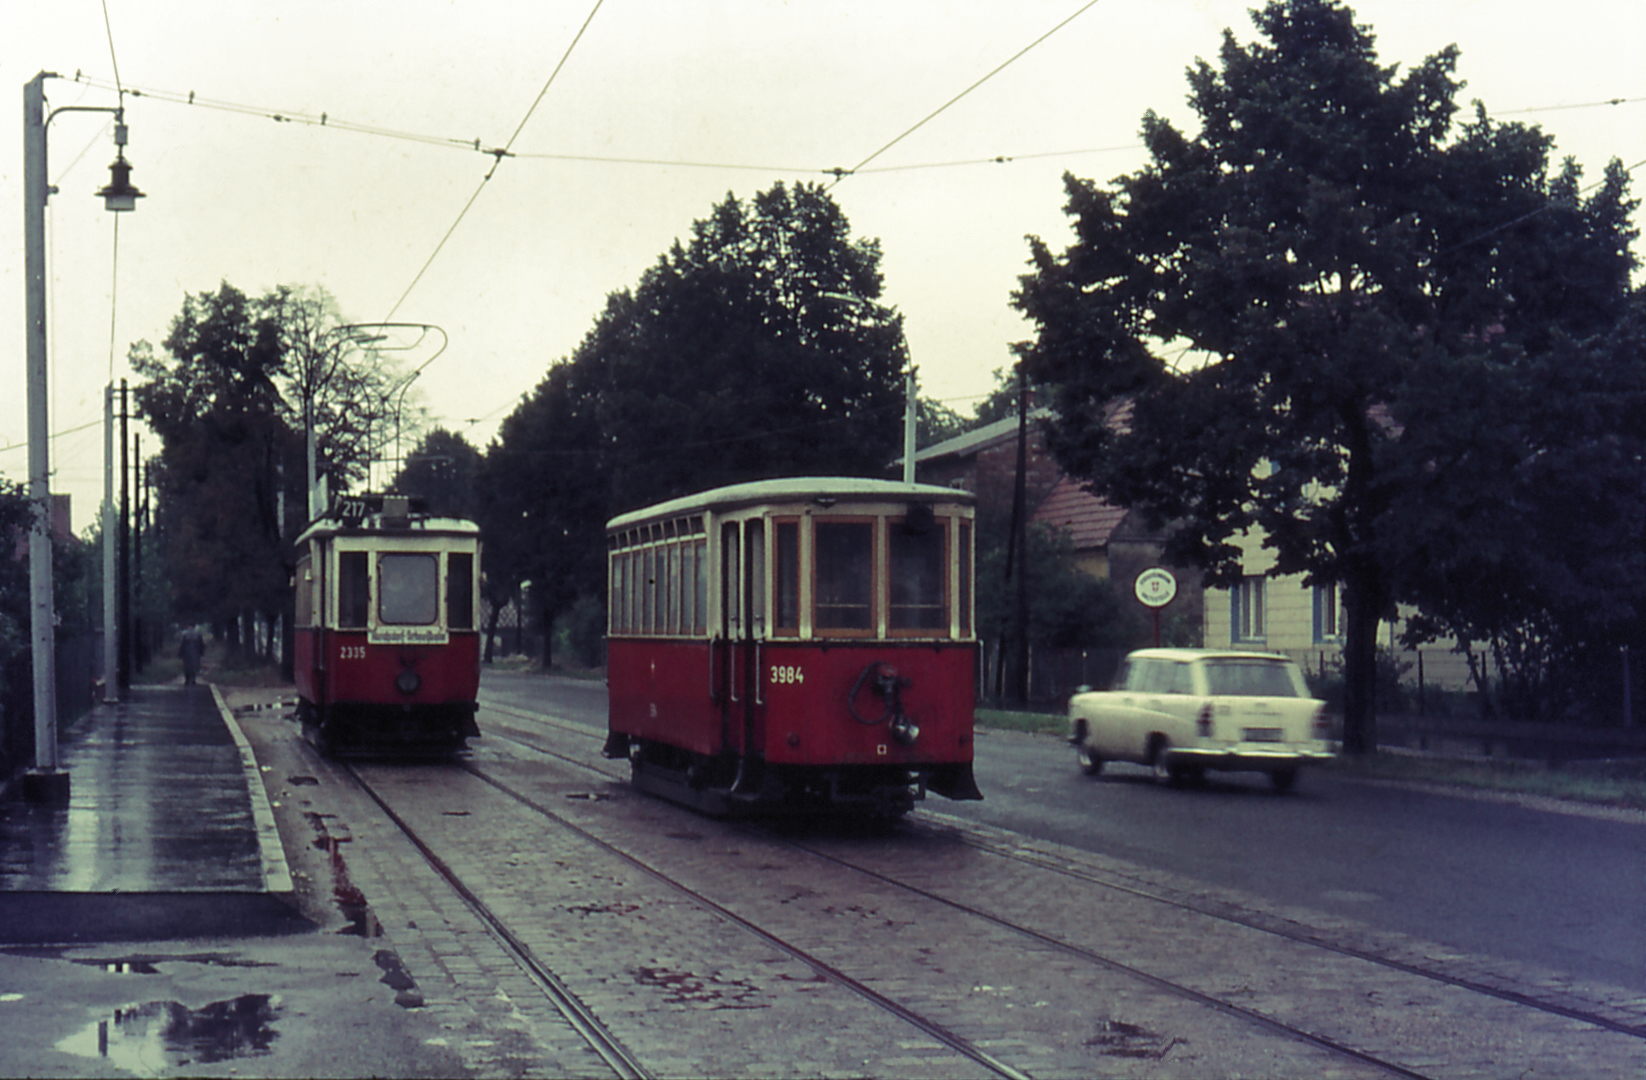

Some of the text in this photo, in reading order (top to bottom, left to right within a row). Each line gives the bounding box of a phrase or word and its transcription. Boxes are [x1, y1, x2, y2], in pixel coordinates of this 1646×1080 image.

[342, 498, 365, 518] 217
[340, 645, 366, 660] 2335
[770, 664, 804, 685] 3984
